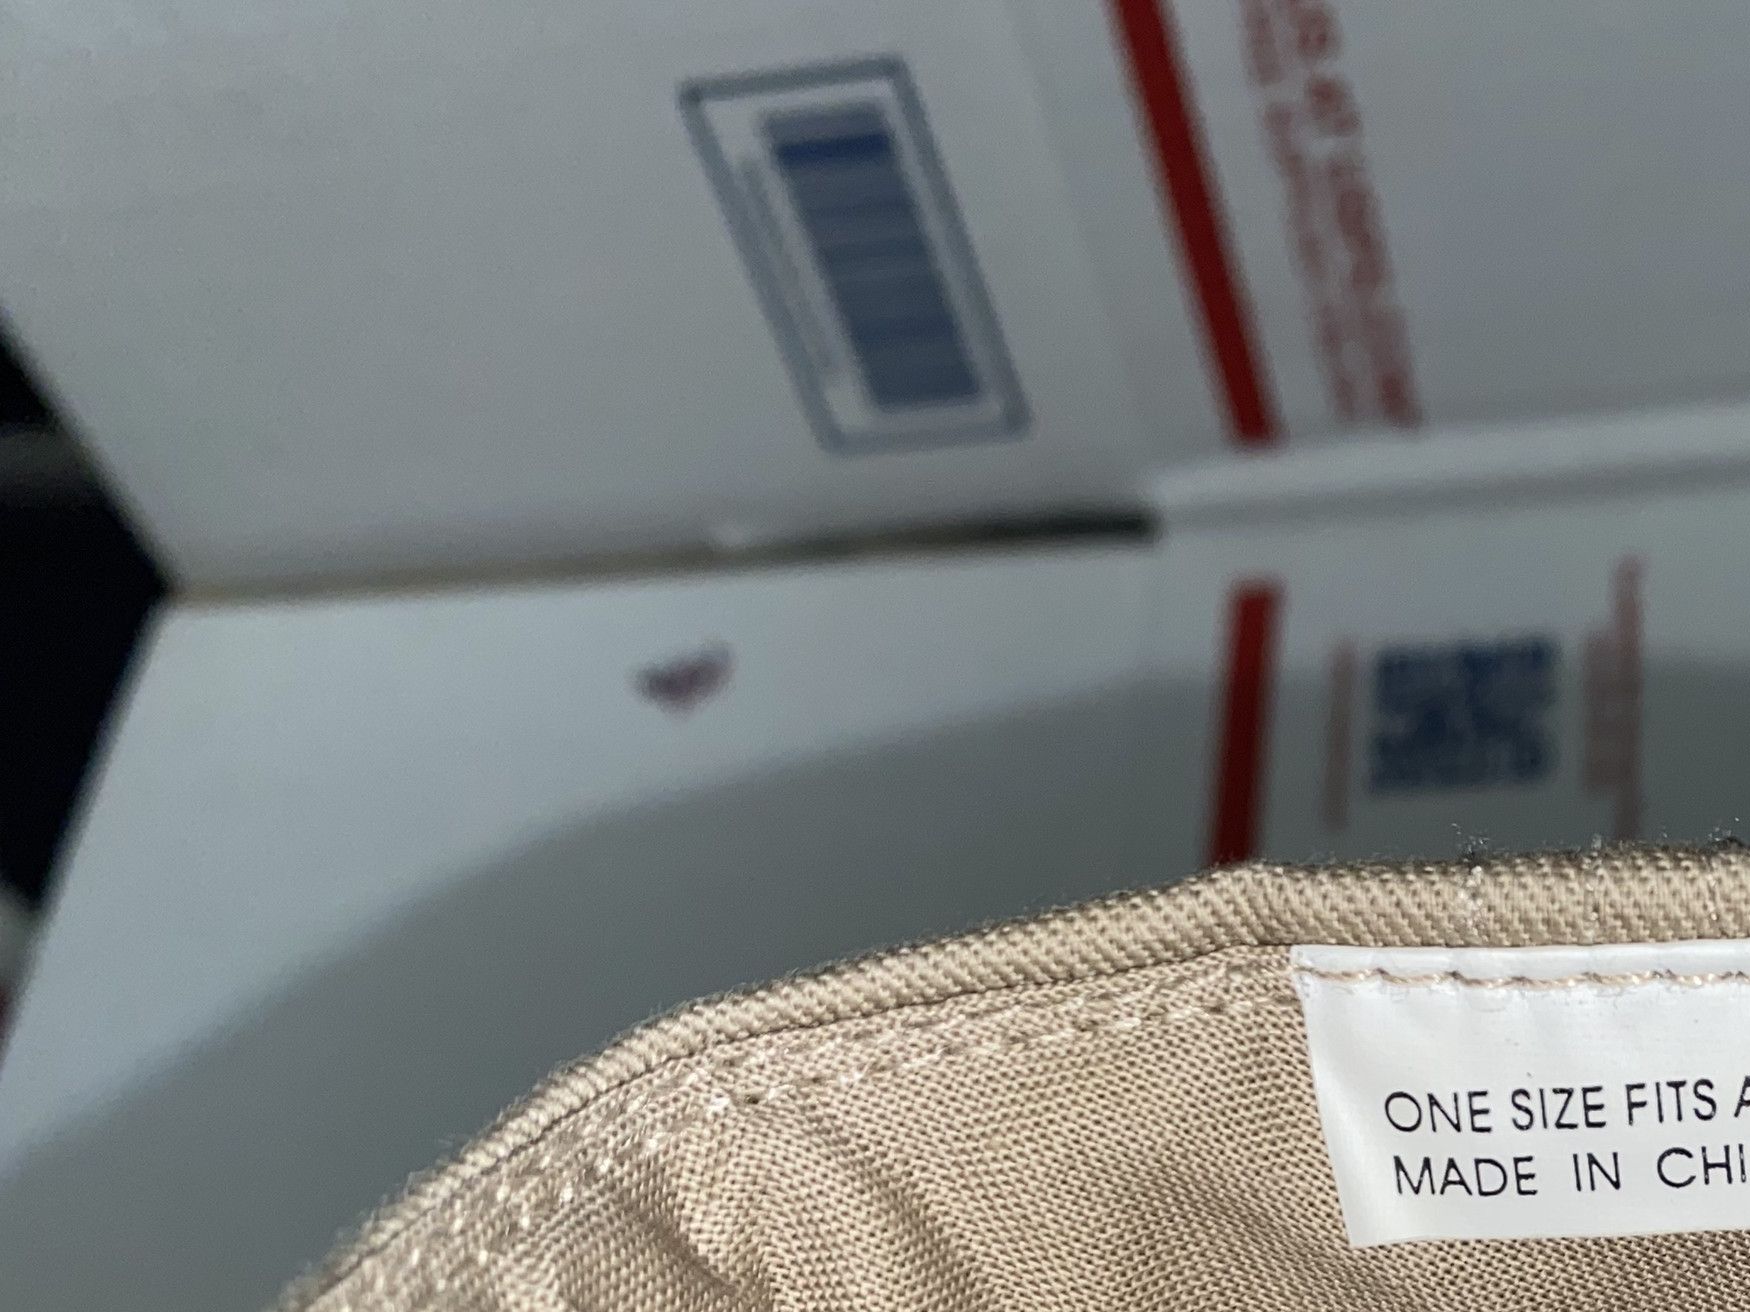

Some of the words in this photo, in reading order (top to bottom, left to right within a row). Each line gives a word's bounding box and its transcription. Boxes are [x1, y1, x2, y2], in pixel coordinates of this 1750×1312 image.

[1384, 1091, 1492, 1133] ONE
[1511, 1085, 1607, 1131] SIZE
[1625, 1078, 1717, 1126] FITS
[1393, 1155, 1538, 1197] MADE
[1572, 1151, 1621, 1192] IN
